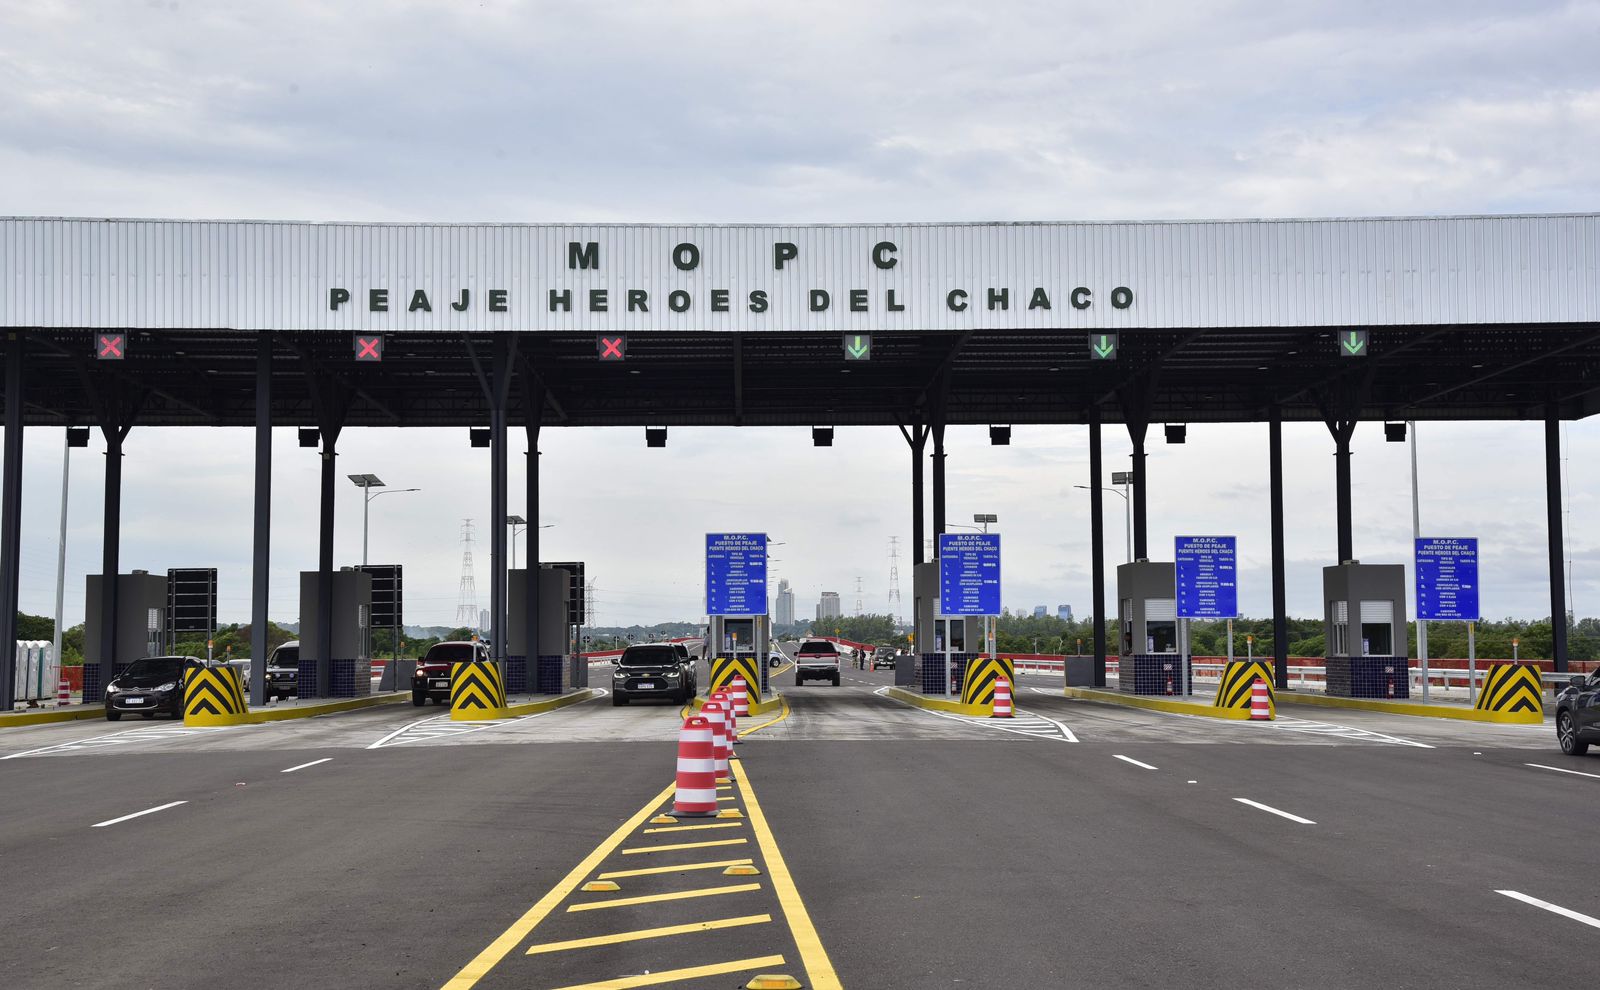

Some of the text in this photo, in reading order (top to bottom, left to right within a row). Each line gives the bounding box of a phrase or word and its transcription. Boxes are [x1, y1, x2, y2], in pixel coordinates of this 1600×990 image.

[330, 286, 1134, 313] PEAJE HEROES DEL CHACO
